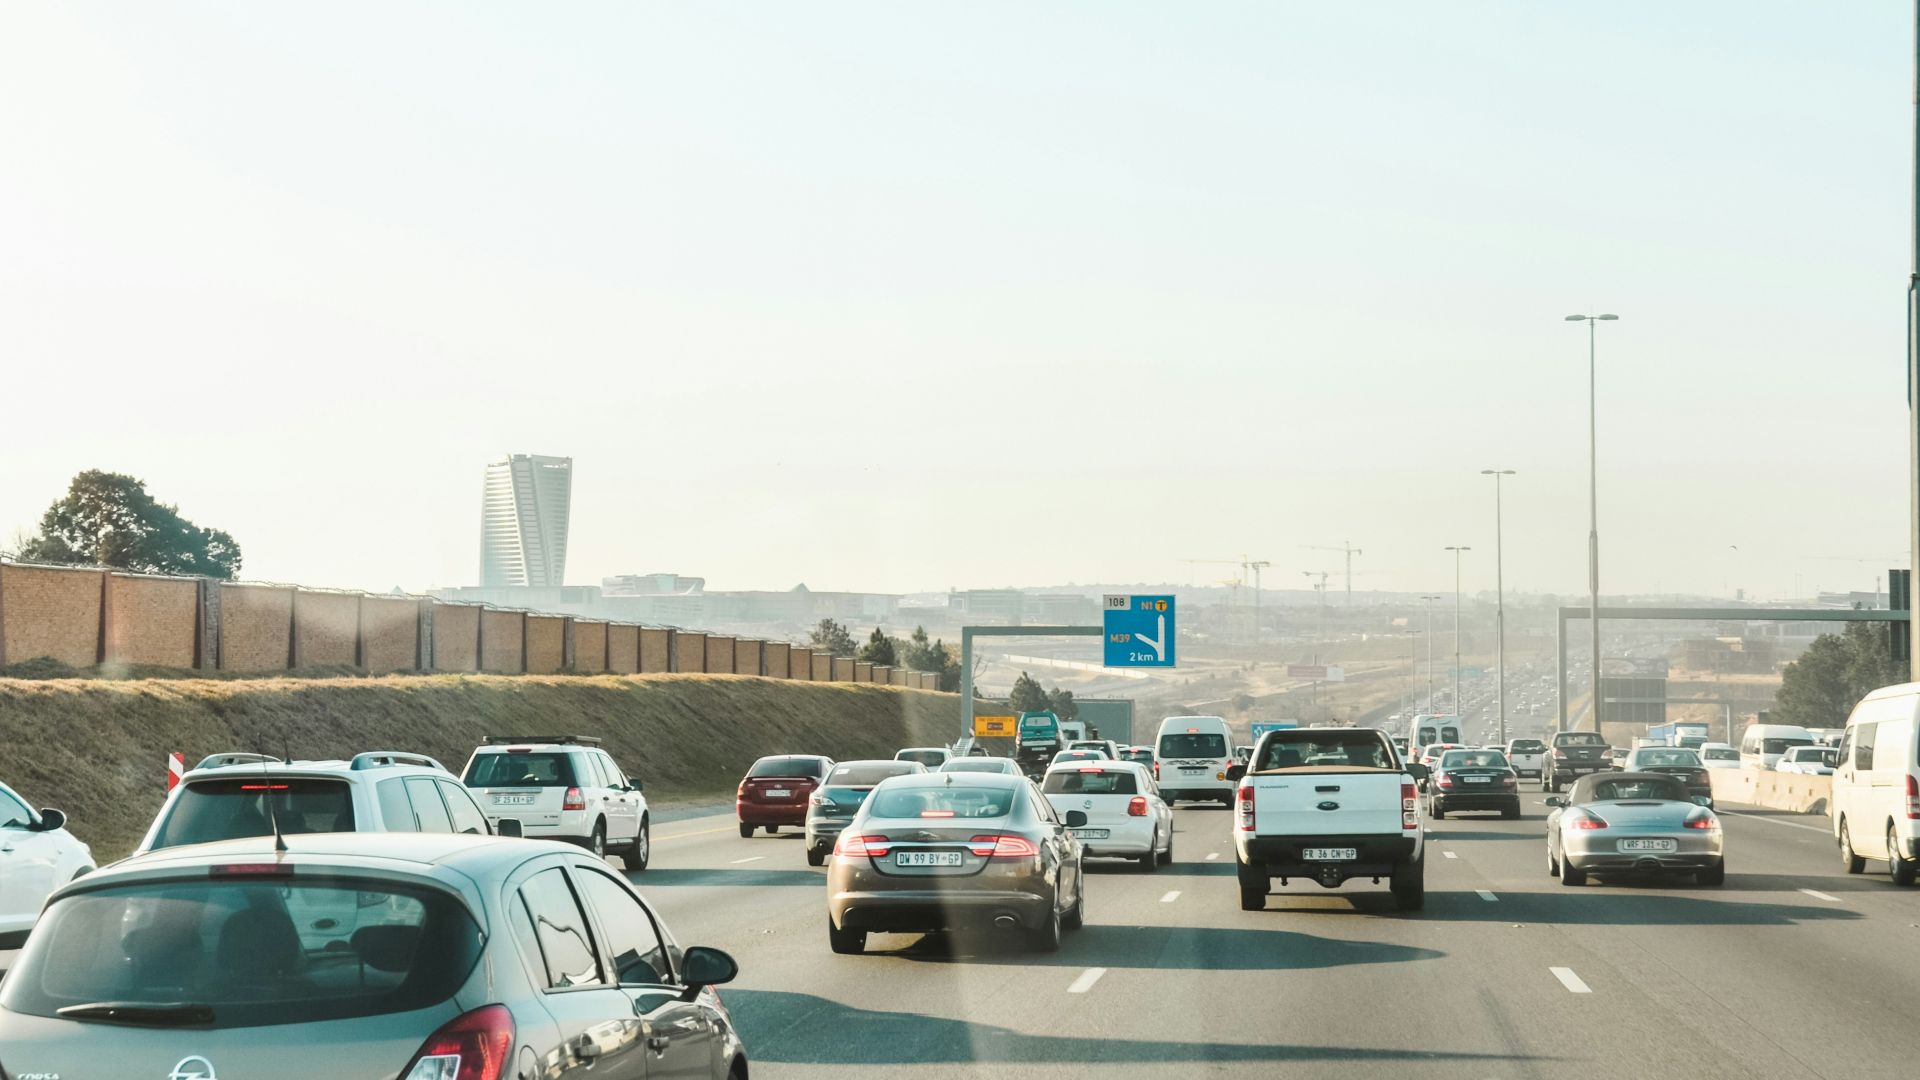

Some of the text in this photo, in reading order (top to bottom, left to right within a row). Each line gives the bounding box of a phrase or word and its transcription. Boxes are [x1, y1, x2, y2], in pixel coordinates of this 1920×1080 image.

[1108, 597, 1125, 607] 108
[1141, 601, 1153, 610] N1
[1110, 633, 1131, 643] M39
[1129, 651, 1154, 661] 2 km
[1627, 840, 1639, 848] WRF
[1643, 840, 1655, 848] 131
[899, 853, 911, 864] DW
[914, 853, 925, 864] 99
[929, 853, 940, 864] BY
[948, 853, 959, 864] GP
[1303, 849, 1355, 858] FR 36 CN GP
